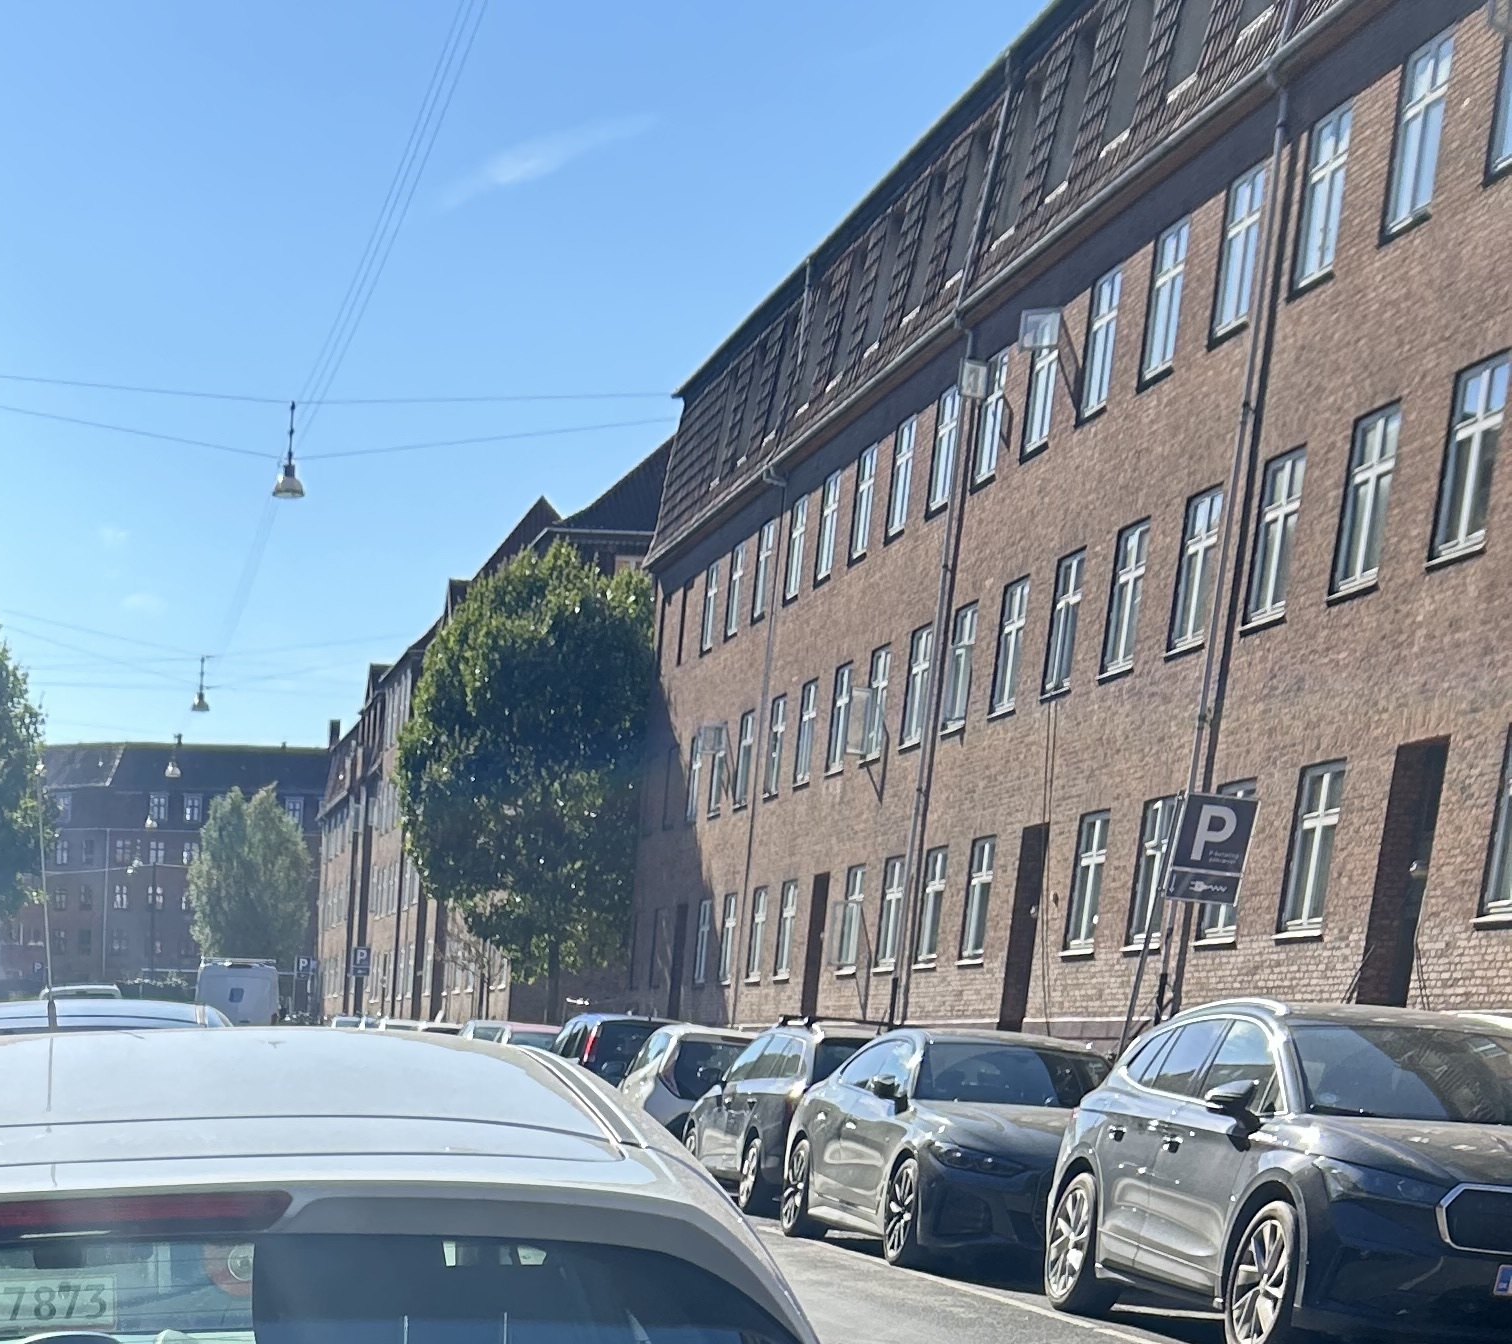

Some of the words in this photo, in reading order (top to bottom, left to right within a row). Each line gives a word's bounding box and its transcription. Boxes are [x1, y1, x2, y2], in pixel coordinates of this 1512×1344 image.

[1190, 804, 1237, 861] P
[299, 958, 308, 971] P
[356, 949, 367, 965] P
[34, 962, 42, 972] P
[33, 1283, 108, 1321] 873
